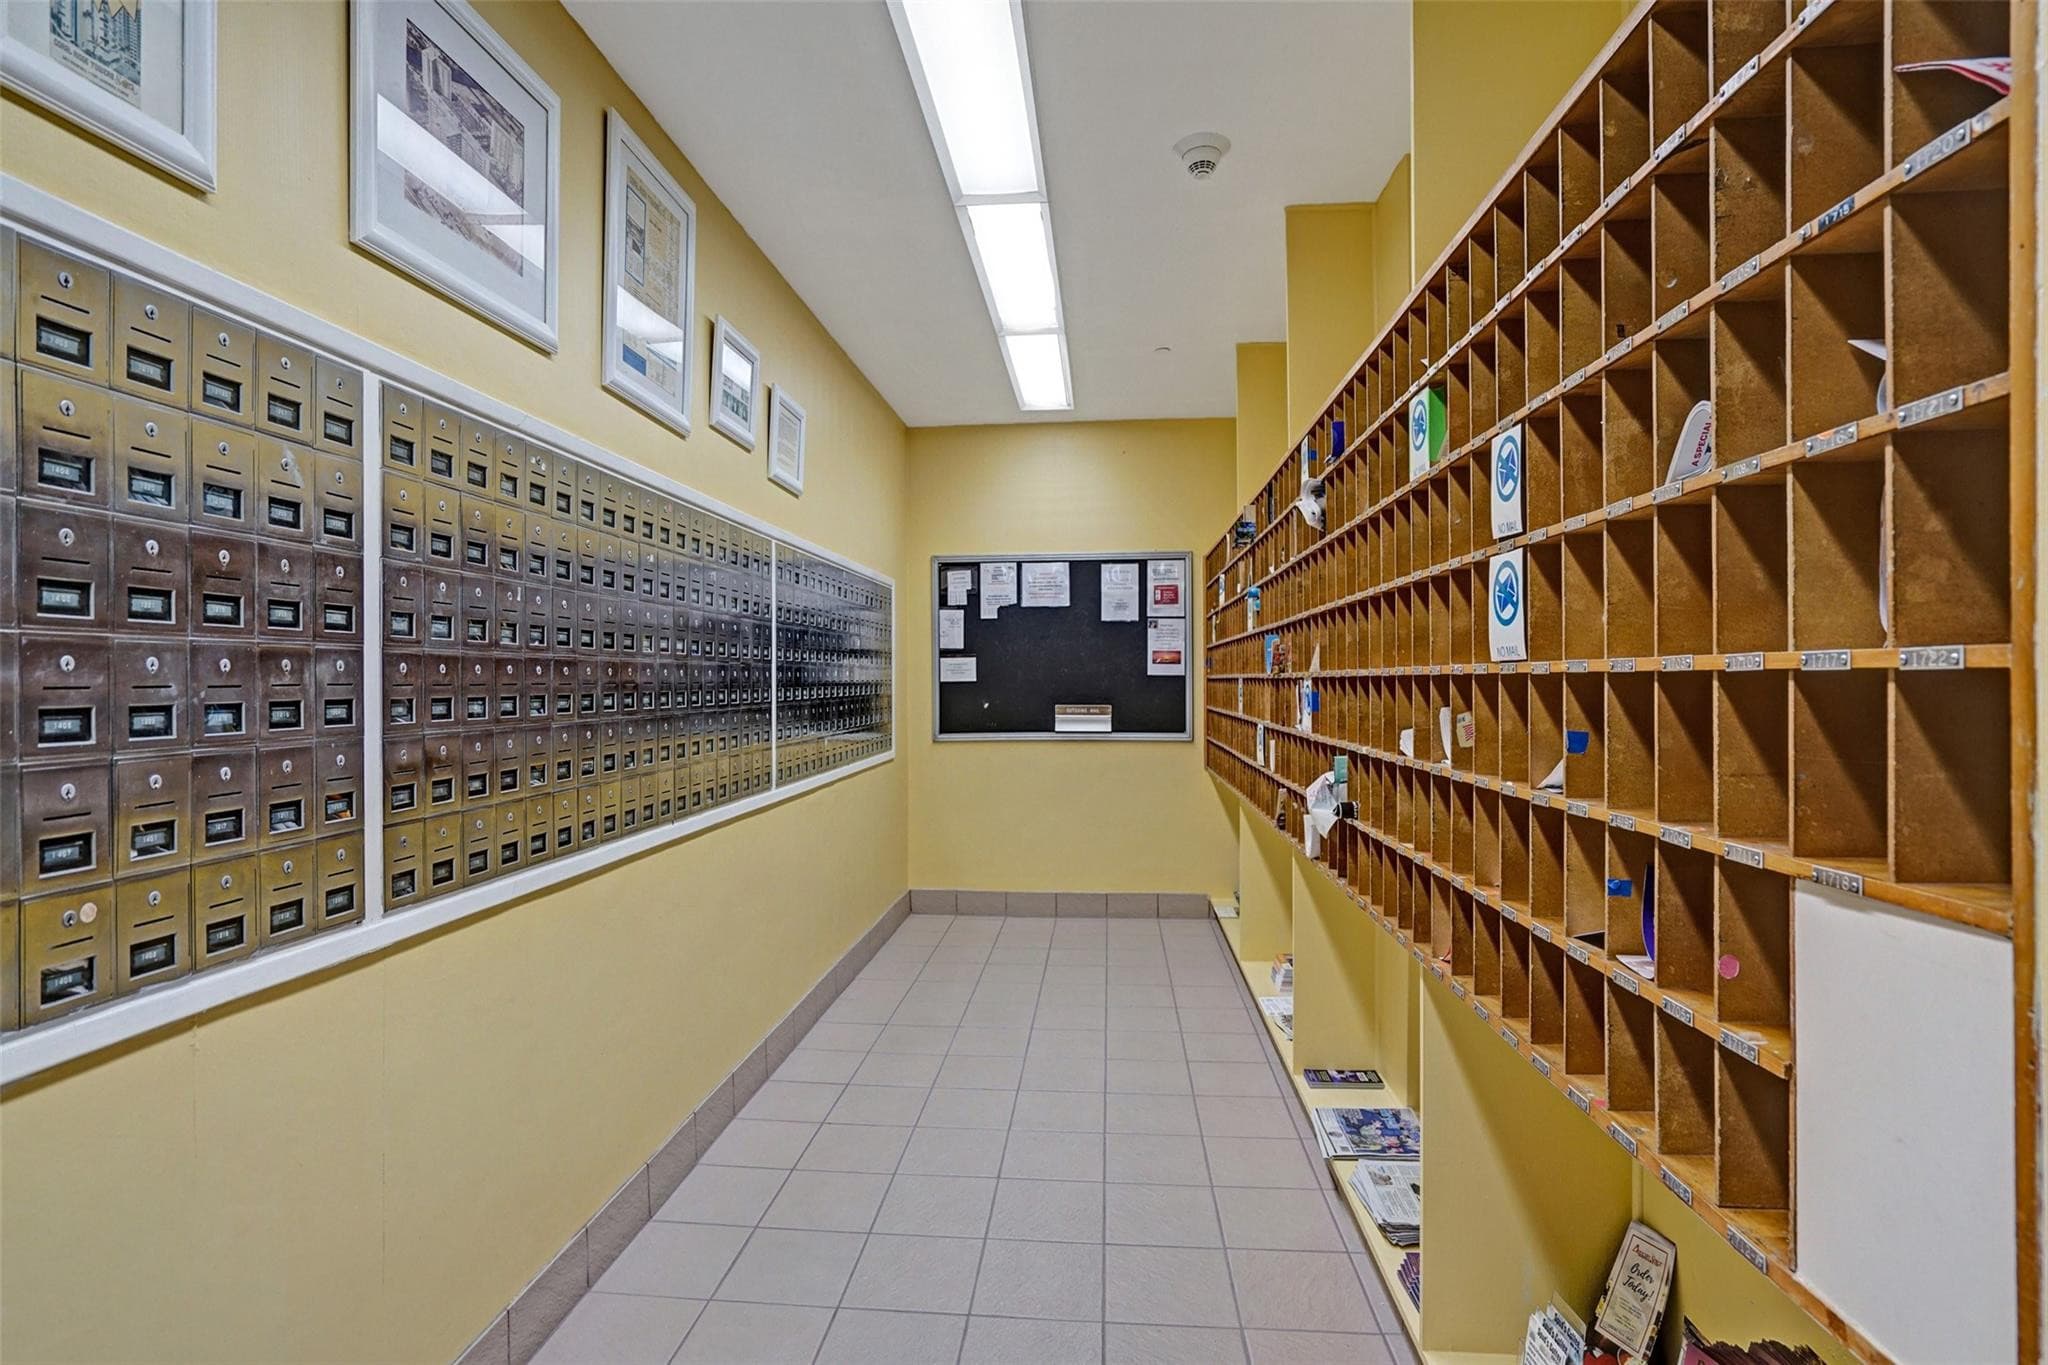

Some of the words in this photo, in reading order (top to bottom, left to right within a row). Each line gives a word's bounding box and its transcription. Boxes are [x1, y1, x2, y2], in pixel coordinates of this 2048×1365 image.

[1911, 400, 1945, 421] 1721
[1505, 644, 1520, 657] MAIL
[1812, 654, 1838, 667] 1717
[1911, 650, 1949, 666] 1722
[1822, 869, 1850, 891] 1718
[1630, 1262, 1654, 1284] Order
[1622, 1275, 1655, 1302] Today!
